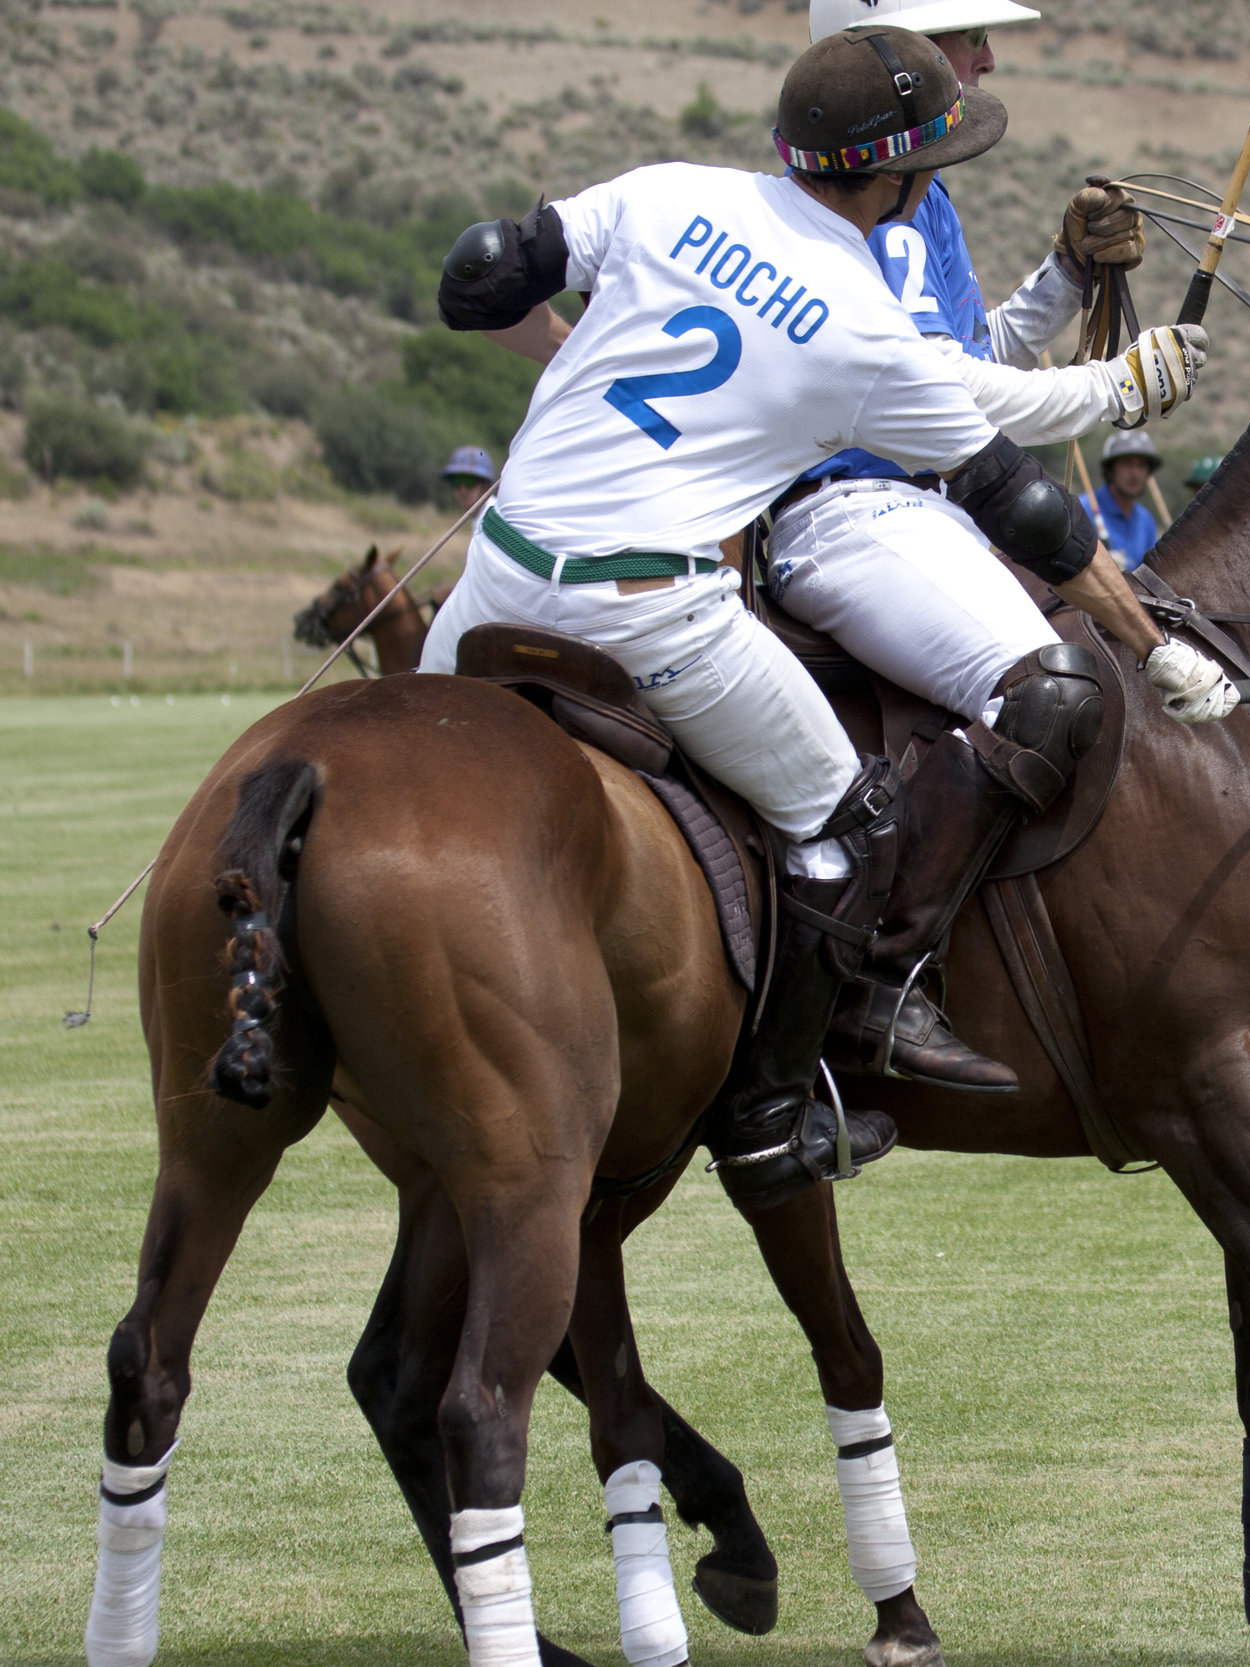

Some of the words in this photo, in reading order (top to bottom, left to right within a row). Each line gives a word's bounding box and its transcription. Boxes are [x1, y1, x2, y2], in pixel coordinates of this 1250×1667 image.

[669, 214, 830, 345] PIOCHO
[885, 225, 940, 313] 2
[602, 305, 742, 451] 2
